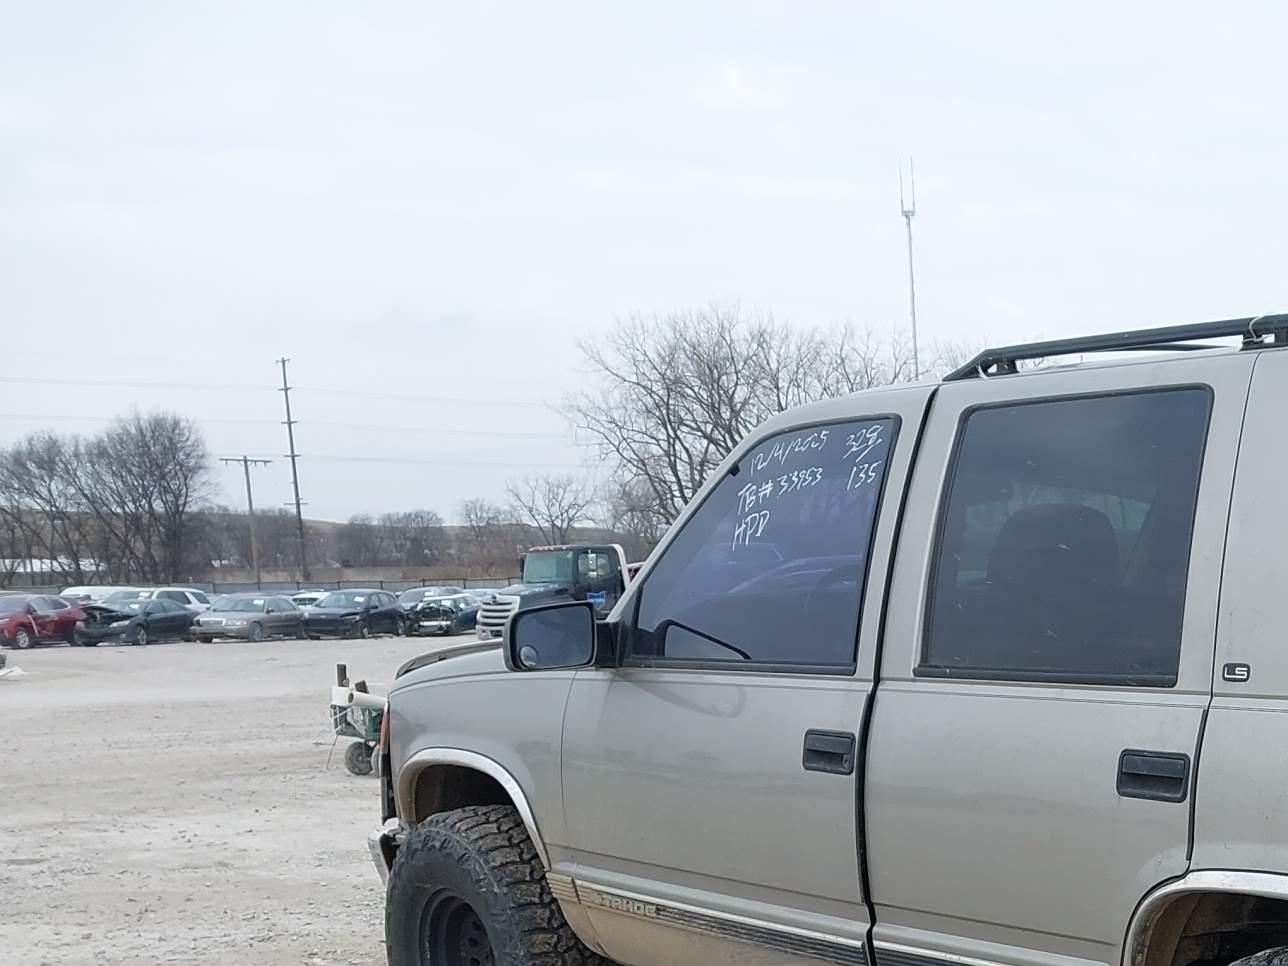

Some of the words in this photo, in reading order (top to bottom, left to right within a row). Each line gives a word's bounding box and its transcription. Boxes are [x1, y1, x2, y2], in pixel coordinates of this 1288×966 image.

[846, 460, 882, 491] 135
[732, 510, 770, 551] HPD
[1224, 666, 1248, 679] LS
[599, 893, 657, 918] TAHOE
